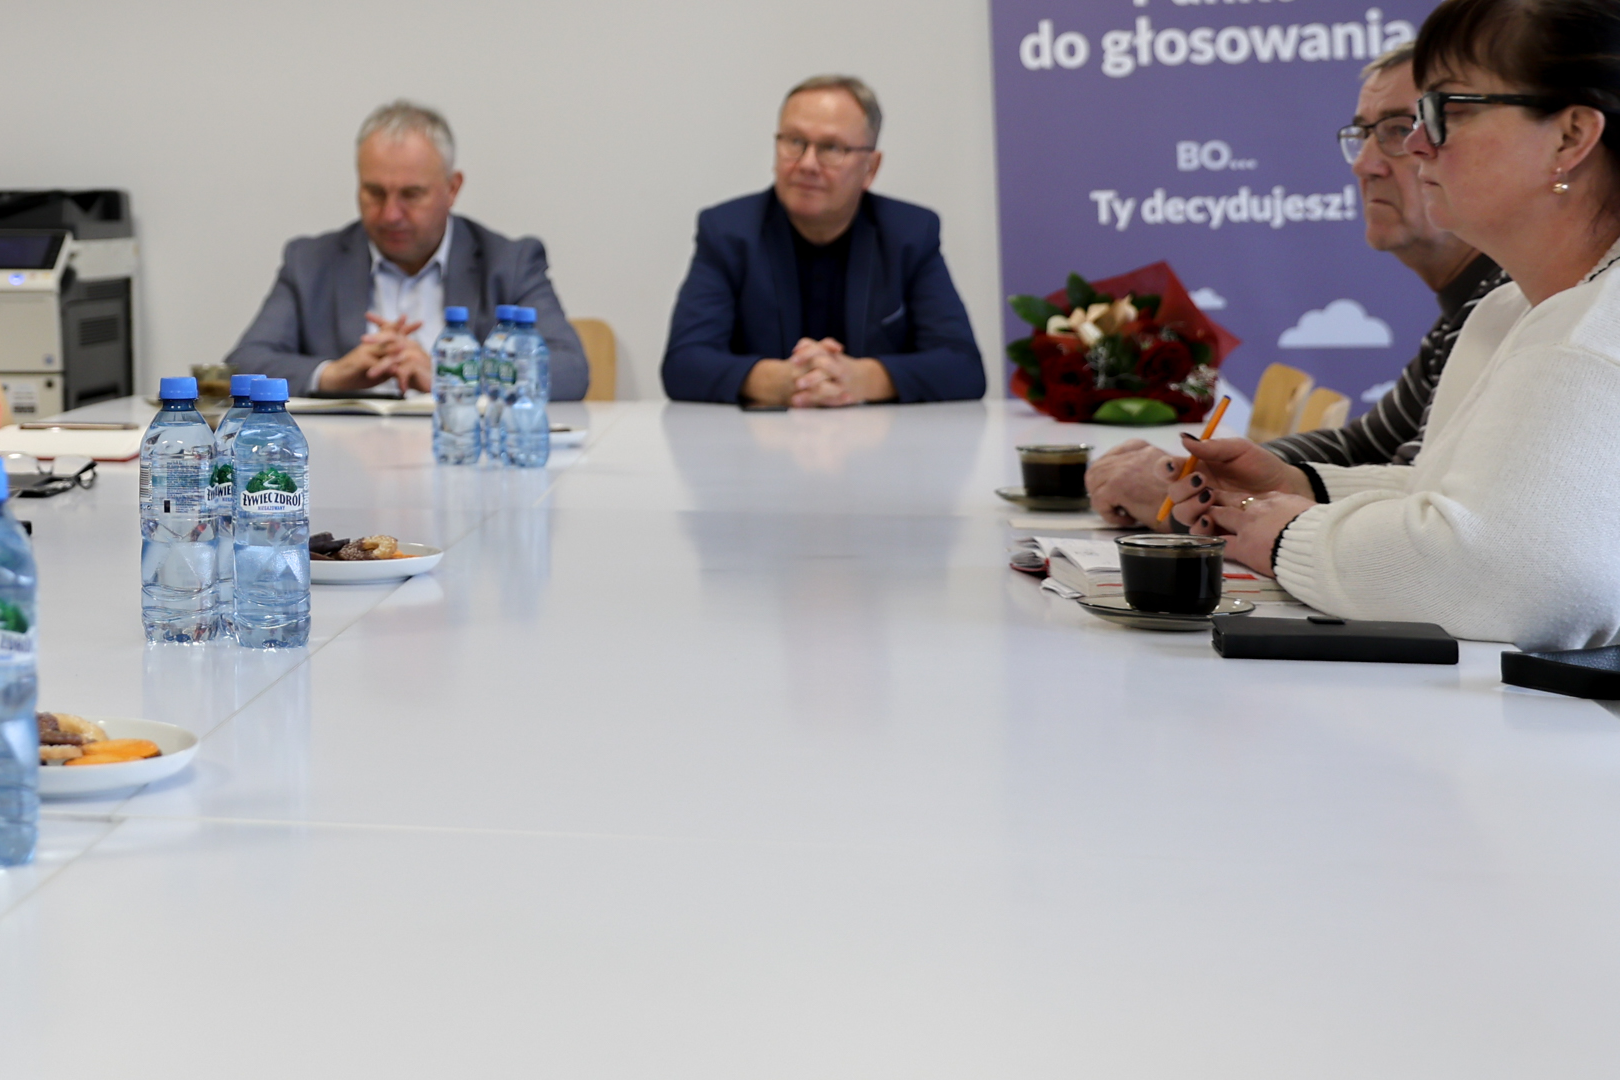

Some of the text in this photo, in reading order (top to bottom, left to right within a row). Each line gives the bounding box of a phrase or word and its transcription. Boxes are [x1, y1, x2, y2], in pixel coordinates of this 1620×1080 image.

[1019, 8, 1416, 78] do głosowania
[1176, 140, 1258, 171] BO...
[1089, 185, 1357, 231] Ty decydujesz!
[242, 492, 301, 507] ŻYWIEC ZDRÓJ
